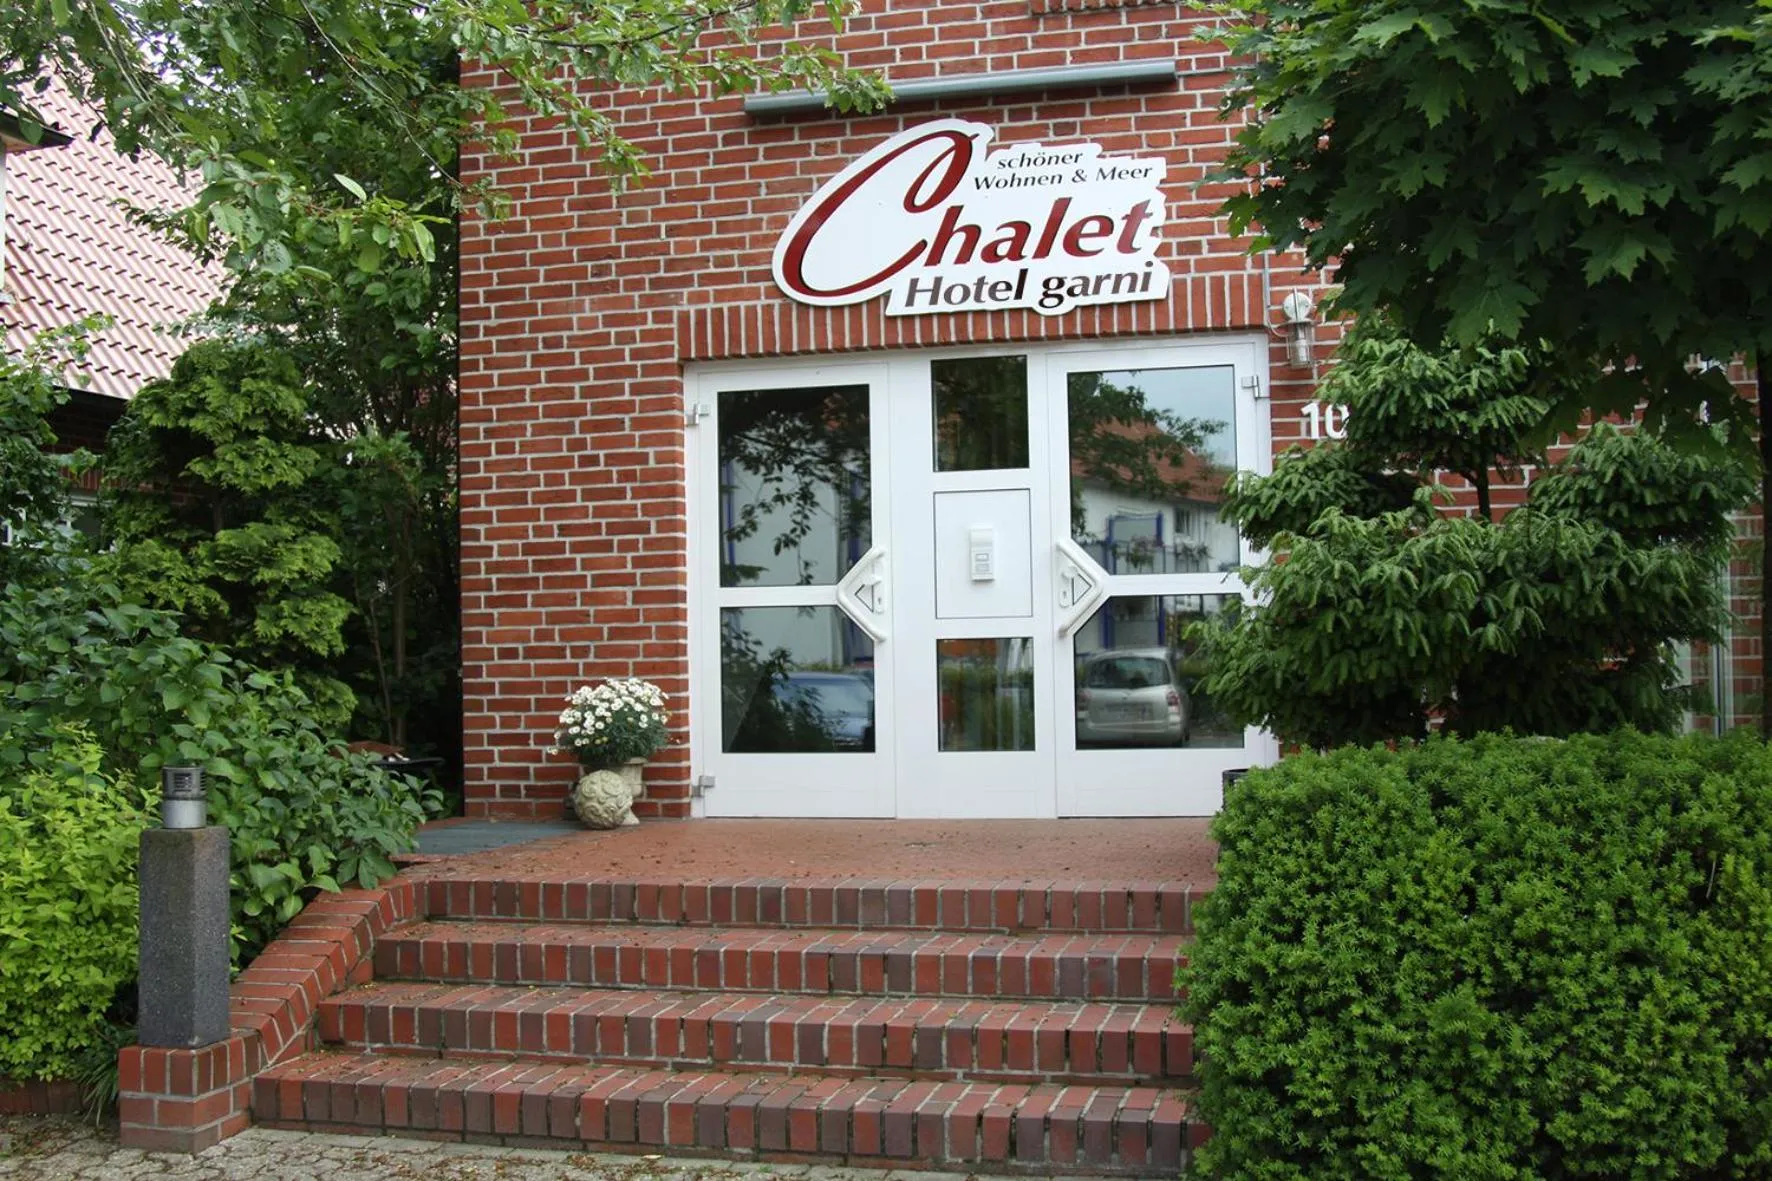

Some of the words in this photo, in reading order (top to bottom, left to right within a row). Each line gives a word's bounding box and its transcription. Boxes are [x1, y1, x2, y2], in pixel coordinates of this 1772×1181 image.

[973, 172, 1063, 190] Wohnen
[1071, 170, 1088, 183] &
[1096, 164, 1153, 181] Meer
[997, 150, 1083, 170] schöner
[782, 129, 1154, 298] Chalet
[904, 267, 1029, 308] Hotel
[1038, 260, 1154, 309] garni
[1300, 401, 1350, 440] 10
